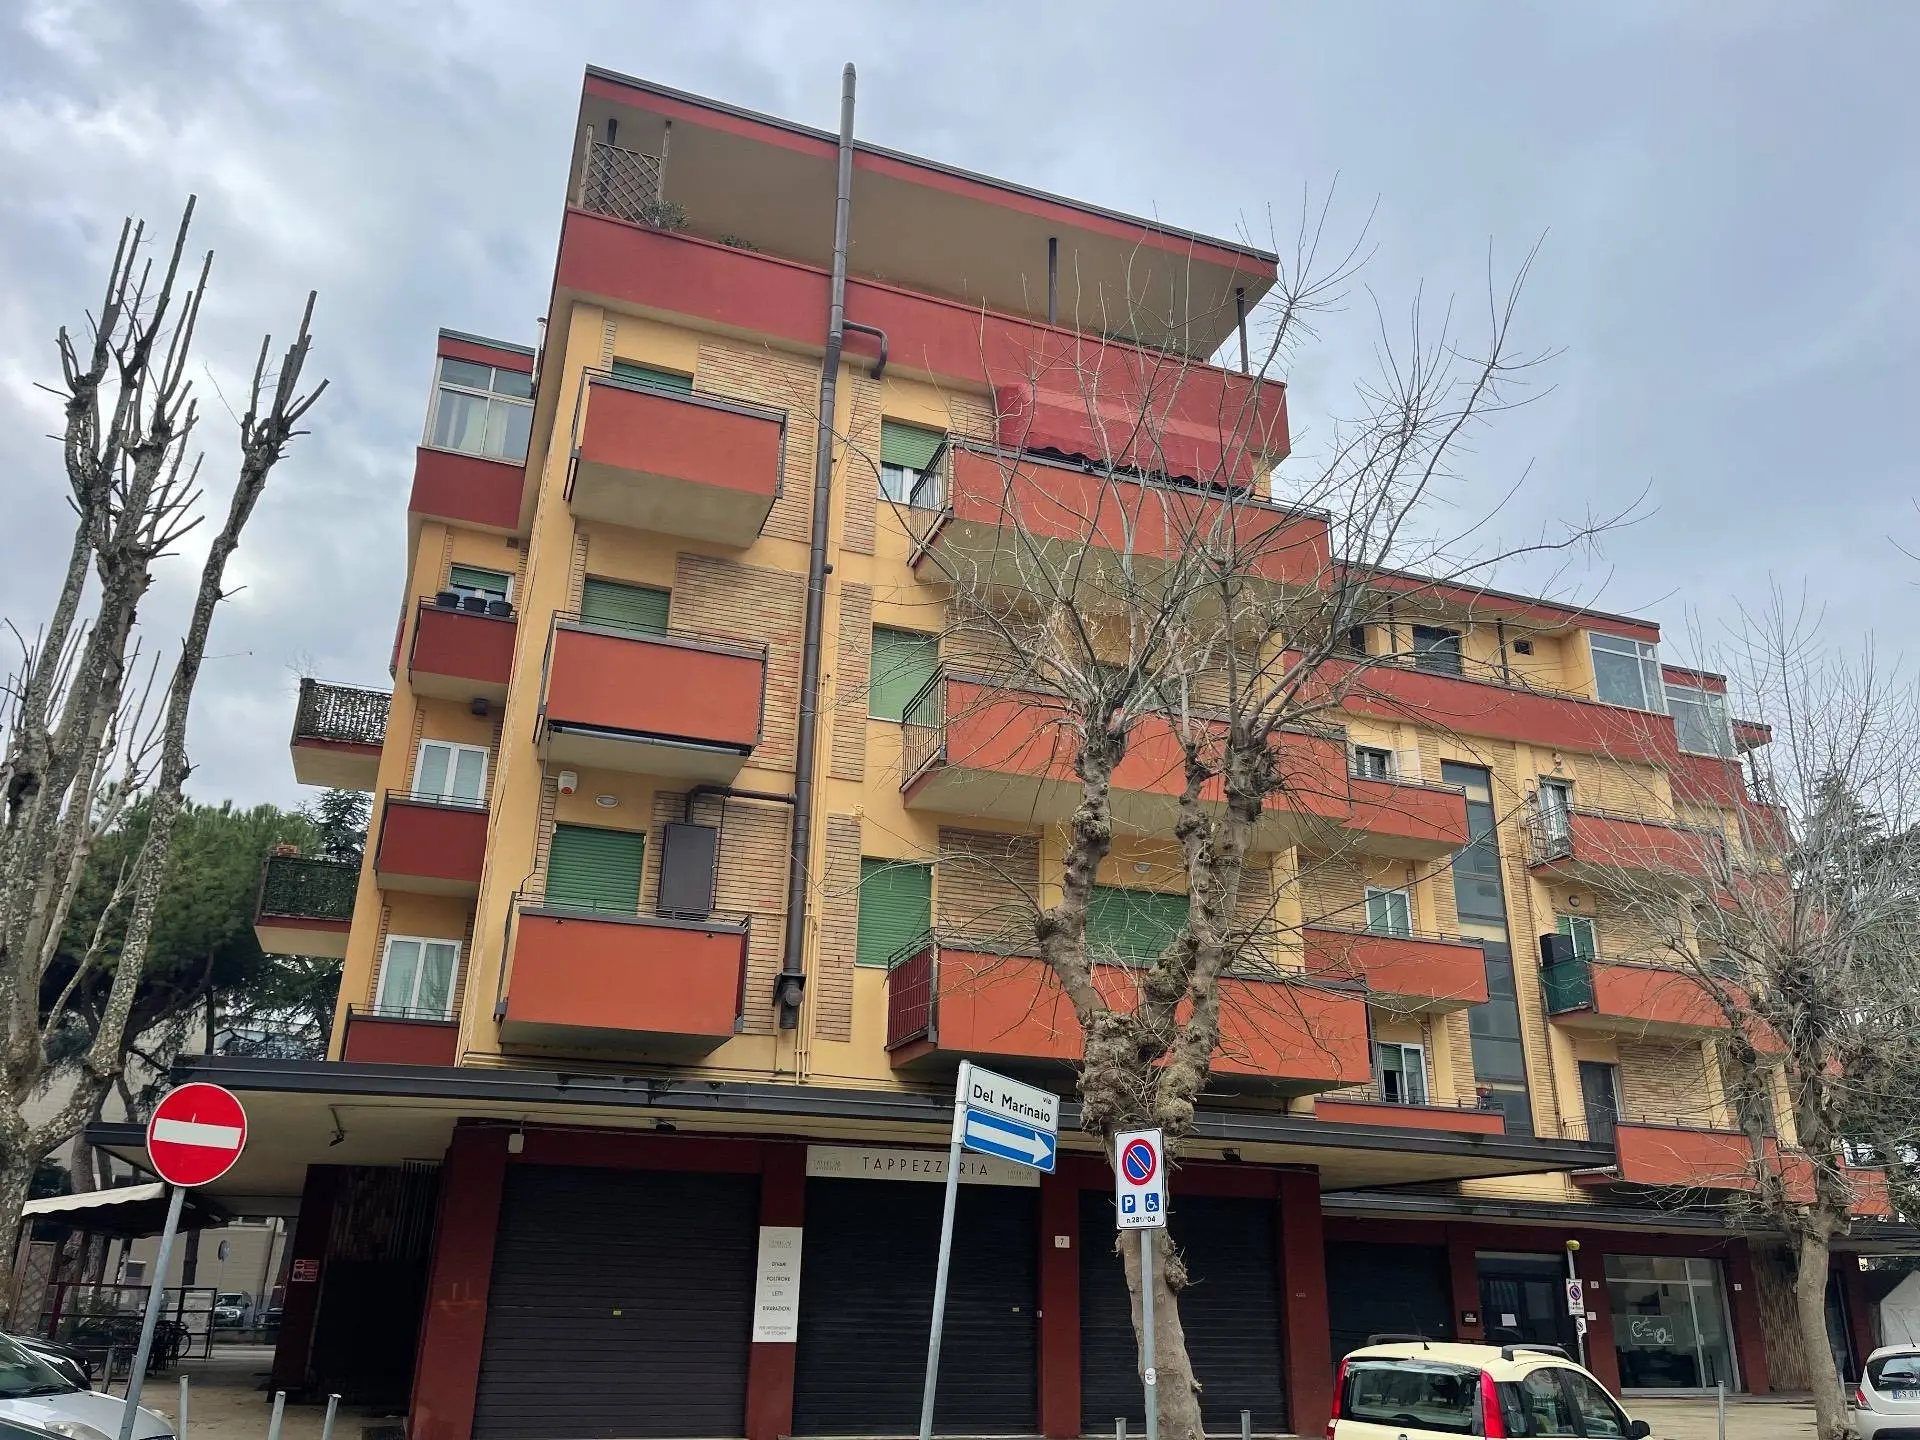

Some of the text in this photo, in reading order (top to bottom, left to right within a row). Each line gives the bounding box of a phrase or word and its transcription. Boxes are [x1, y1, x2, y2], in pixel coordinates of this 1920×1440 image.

[973, 1084, 1051, 1123] Del Marinaio
[1042, 1096, 1052, 1105] via
[862, 1156, 988, 1176] TAPPEZZRIA
[1124, 1196, 1134, 1212] P
